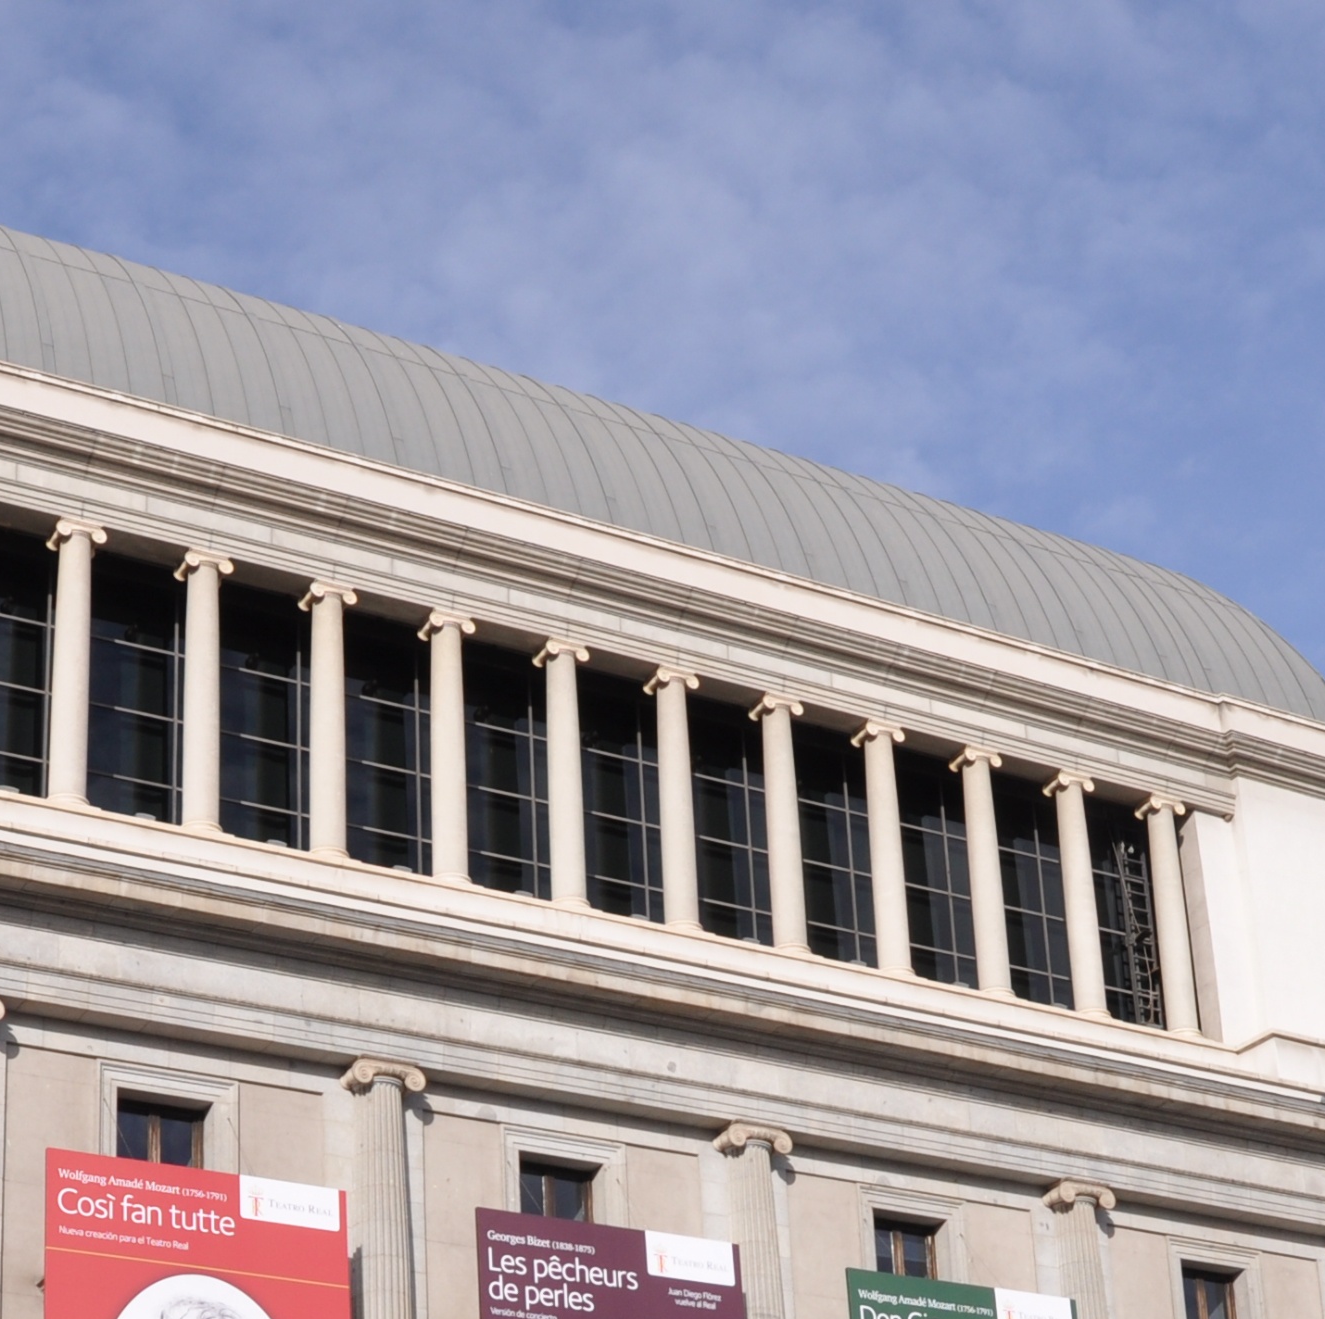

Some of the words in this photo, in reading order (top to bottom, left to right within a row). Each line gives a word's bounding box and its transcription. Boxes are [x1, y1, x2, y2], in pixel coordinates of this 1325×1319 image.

[58, 1168, 107, 1187] Wolfgang
[108, 1175, 144, 1190] Amadé
[145, 1179, 181, 1195] Mozart
[57, 1187, 115, 1220] Così
[121, 1194, 162, 1227] fan
[169, 1204, 236, 1237] tutte
[59, 1225, 84, 1237] Nueva
[84, 1228, 118, 1241] creación
[119, 1232, 136, 1245] para
[137, 1233, 145, 1244] el
[146, 1236, 172, 1248] Teatro
[172, 1239, 189, 1250] Real
[487, 1230, 525, 1246] Georges
[526, 1235, 551, 1249] Bizet
[488, 1247, 527, 1274] Les
[533, 1255, 639, 1291] pêcheurs
[488, 1275, 518, 1302] de
[525, 1283, 595, 1312] perles
[668, 1286, 683, 1297] Juan
[684, 1288, 702, 1300] Diego
[858, 1288, 897, 1305] Wolfgang
[898, 1294, 926, 1308] Amadé
[927, 1298, 956, 1312] Mozart
[490, 1306, 516, 1318] Versión
[516, 1309, 525, 1319] de
